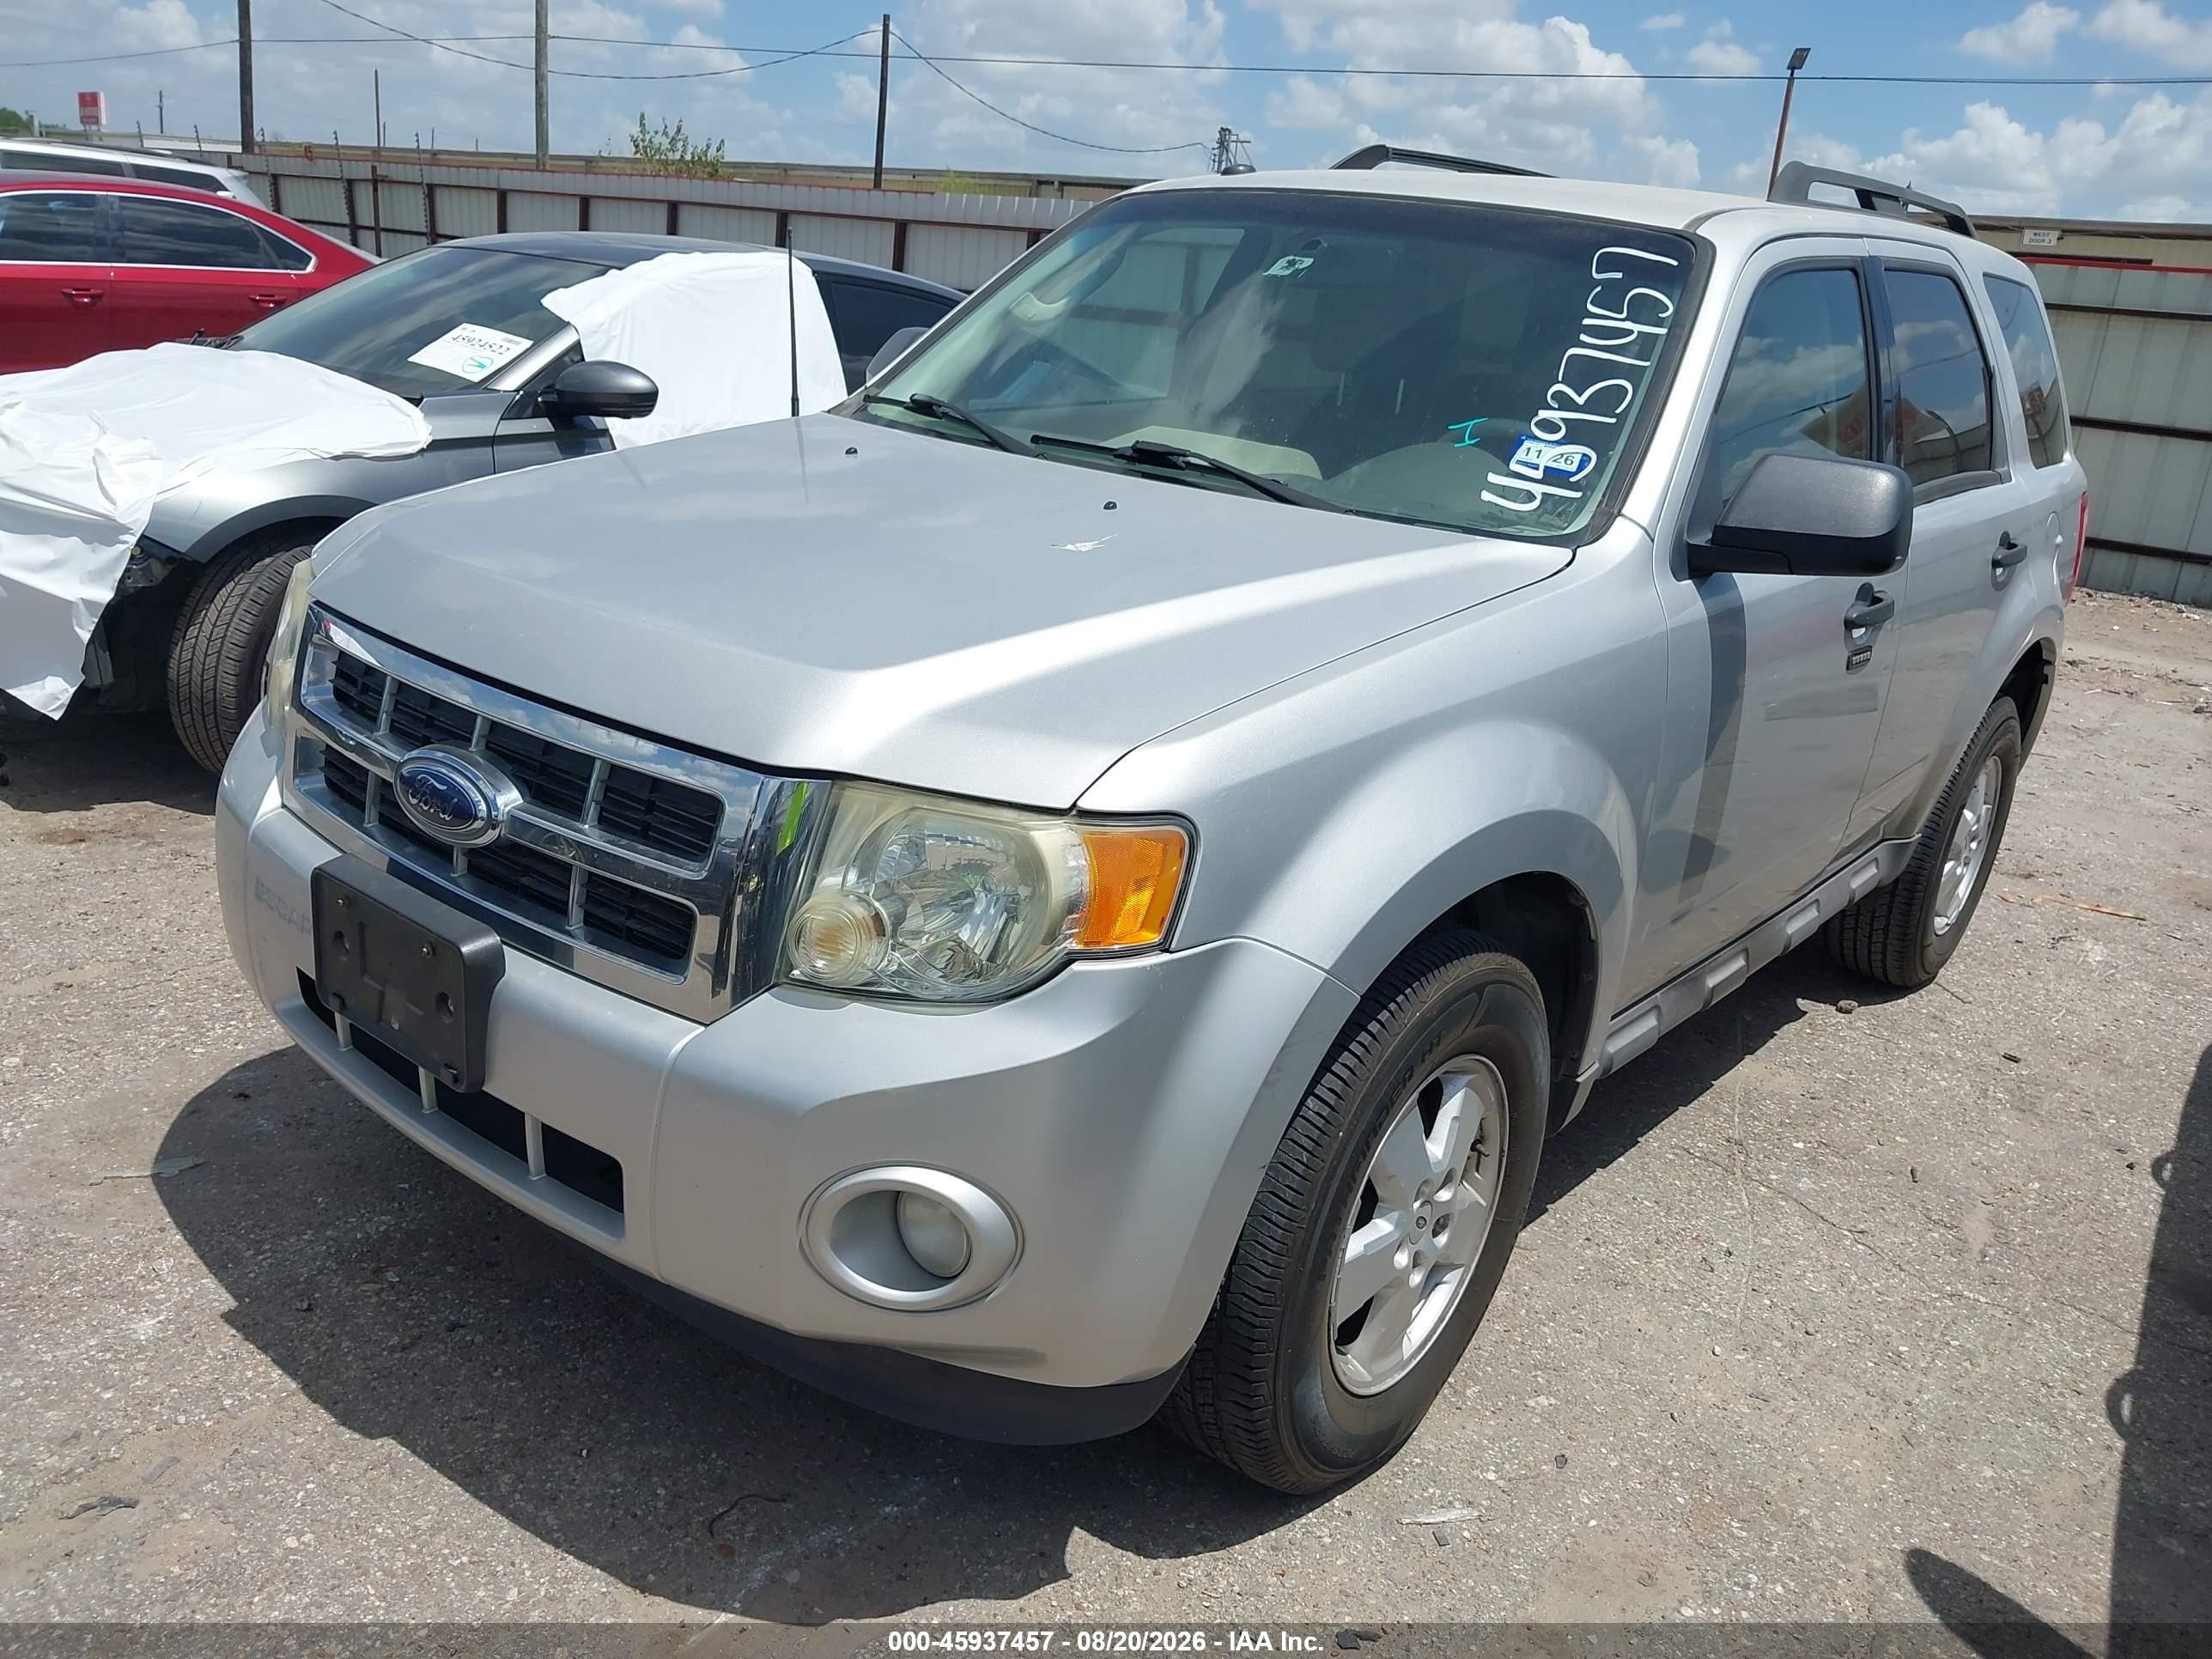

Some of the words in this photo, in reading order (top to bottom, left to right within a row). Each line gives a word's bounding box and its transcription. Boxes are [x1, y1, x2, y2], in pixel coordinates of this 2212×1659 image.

[1480, 246, 1679, 512] 45937457
[1523, 447, 1543, 459] 11
[1551, 453, 1576, 466] 26
[408, 774, 456, 821] Ford
[254, 876, 313, 938] ESCAP
